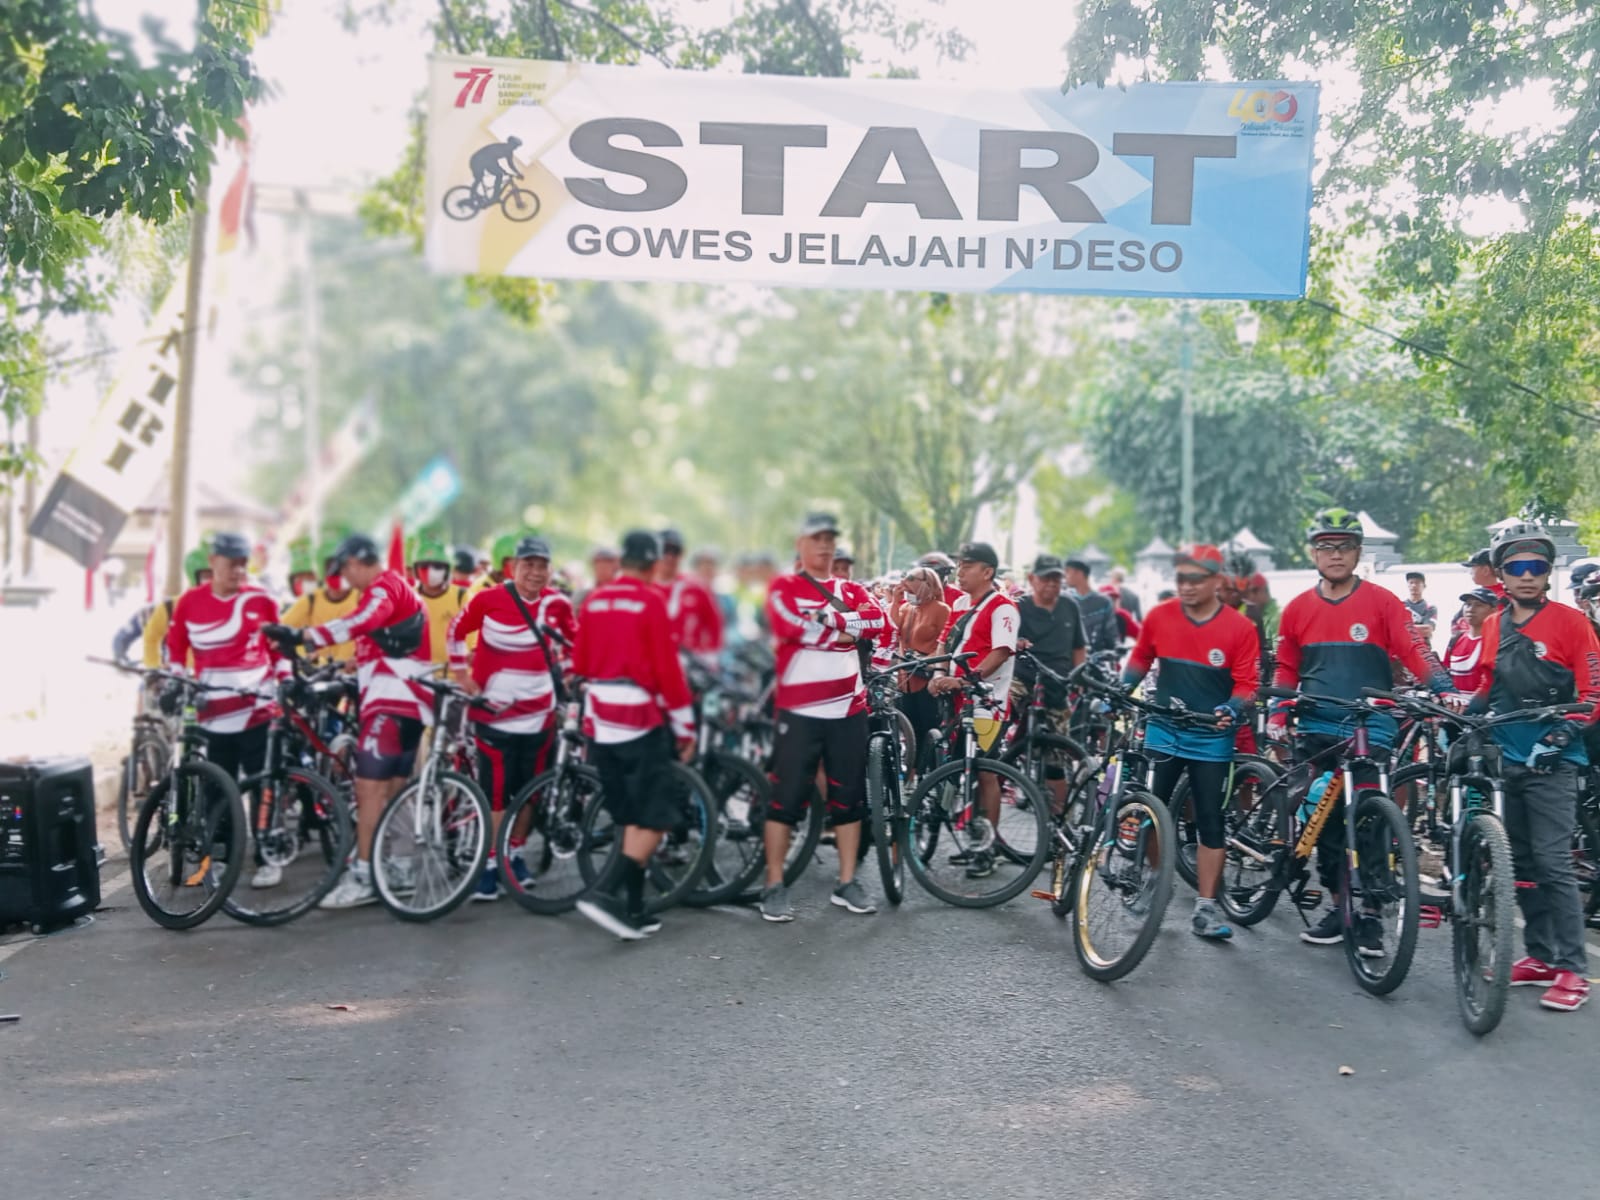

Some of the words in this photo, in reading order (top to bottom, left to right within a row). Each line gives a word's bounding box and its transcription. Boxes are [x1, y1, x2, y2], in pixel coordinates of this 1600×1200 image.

[454, 68, 494, 108] 77
[1228, 89, 1298, 123] 400
[564, 117, 1238, 227] START
[567, 224, 753, 262] GOWES
[769, 232, 986, 269] JELAJAH
[1005, 238, 1183, 273] N'DESO
